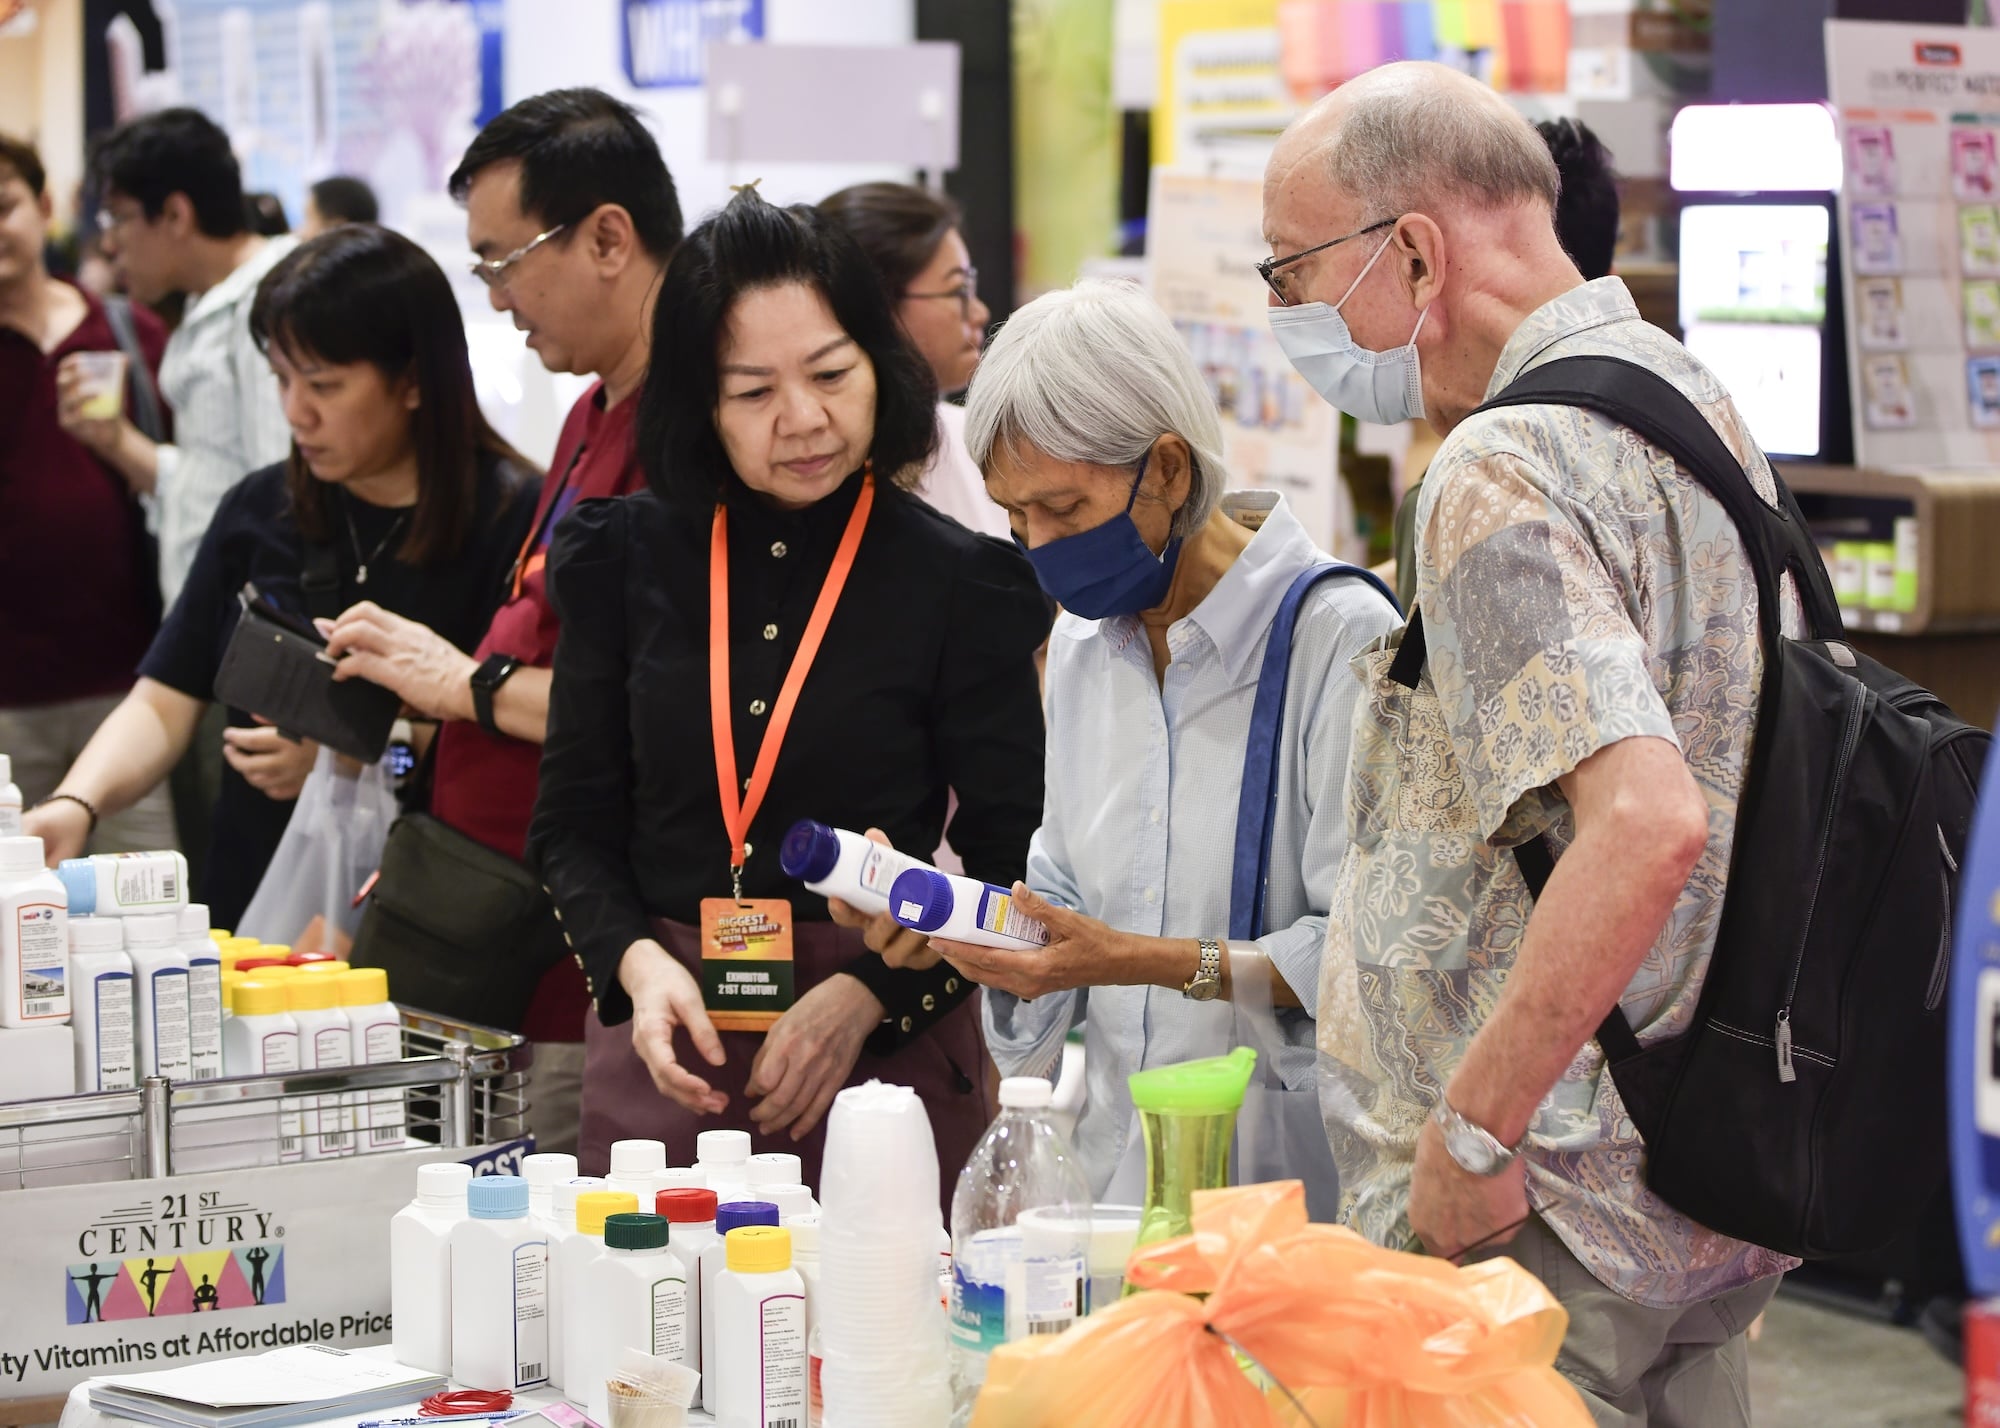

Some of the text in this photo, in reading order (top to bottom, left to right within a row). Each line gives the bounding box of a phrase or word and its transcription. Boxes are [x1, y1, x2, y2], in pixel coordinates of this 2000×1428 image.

[718, 914, 766, 929] BIGGEST
[726, 971, 770, 983] EXHIBITOR
[717, 984, 779, 996] 21ST CENTURY
[160, 1191, 220, 1220] 21 ST
[0, 1352, 29, 1382] ty
[34, 1337, 157, 1372] Vitamins
[162, 1334, 191, 1358] at
[196, 1318, 335, 1355] Affordable
